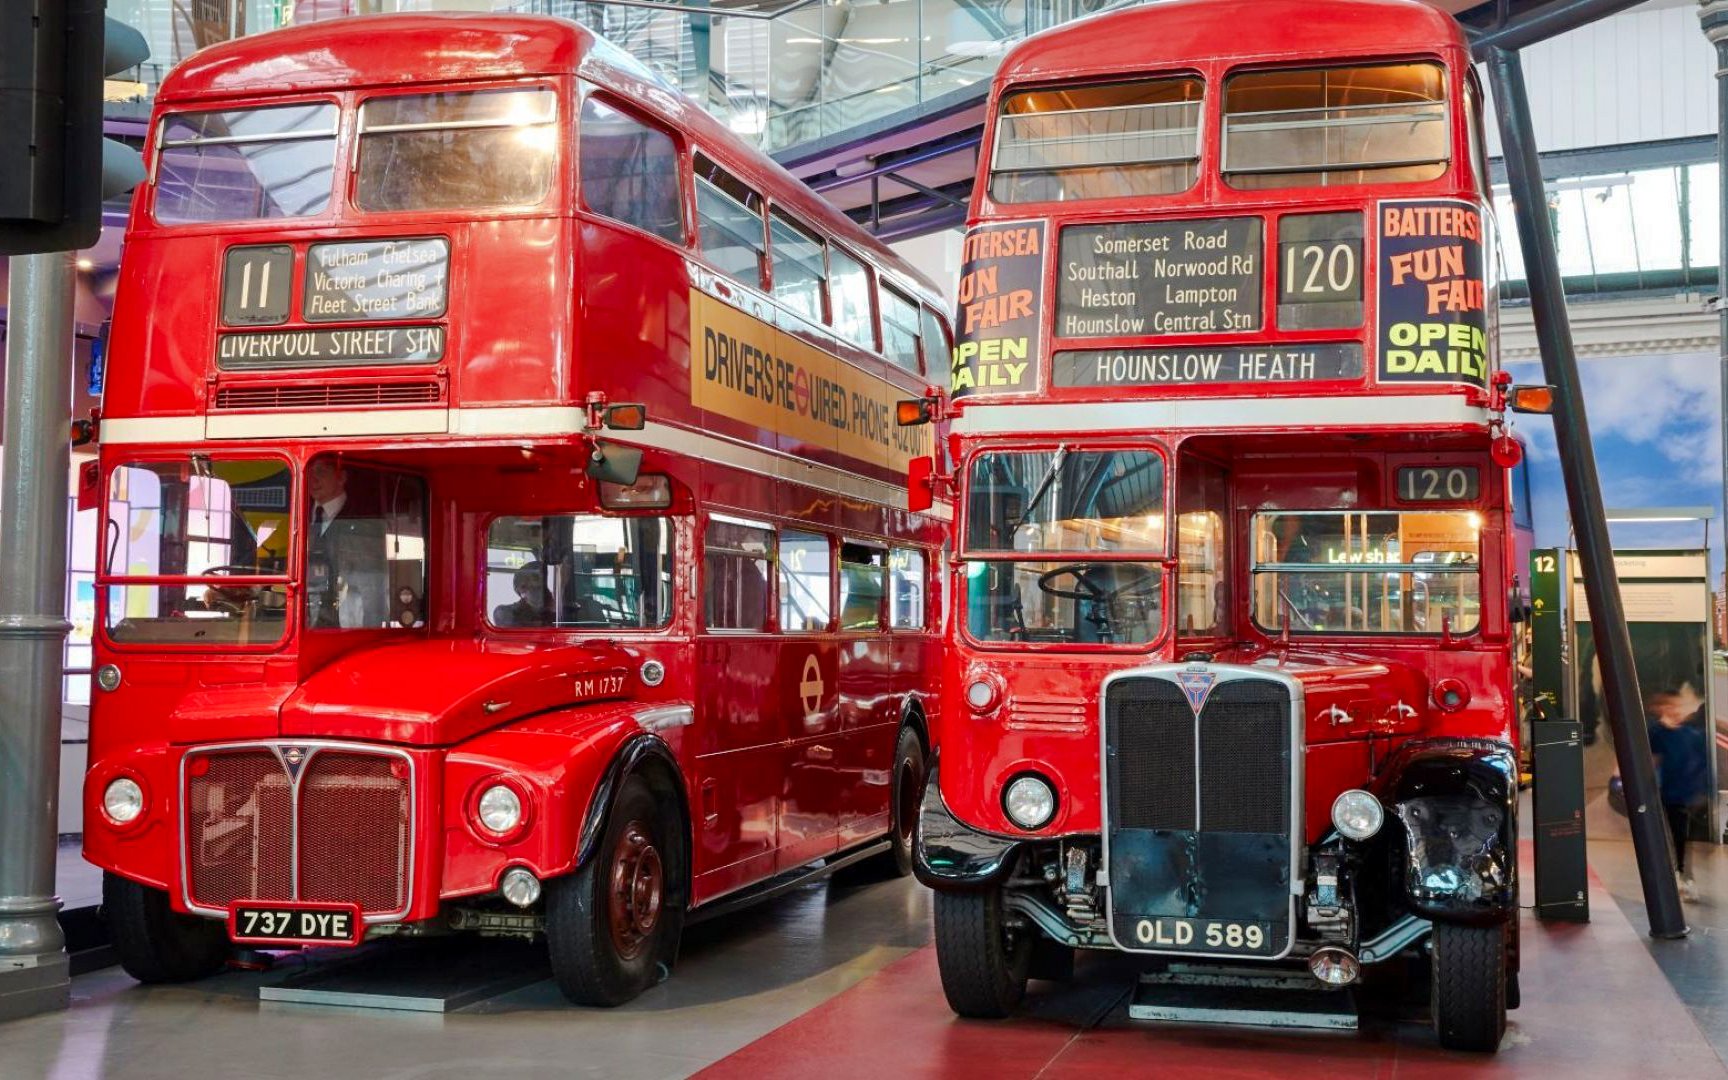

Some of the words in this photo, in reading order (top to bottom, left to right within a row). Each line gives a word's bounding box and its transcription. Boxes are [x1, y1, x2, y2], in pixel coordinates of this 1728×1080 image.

[321, 249, 368, 267] Fulham
[382, 245, 437, 263] Chelsea
[1094, 235, 1170, 254] Somerset
[1184, 230, 1228, 250] Road
[314, 272, 366, 291] Victoria
[377, 268, 426, 291] Charing
[1068, 260, 1139, 281] Southall
[1154, 255, 1227, 278] Norwood
[1231, 255, 1254, 275] Rd
[1286, 244, 1355, 294] 120
[1390, 246, 1465, 286] FUN
[240, 261, 270, 309] 11
[1081, 289, 1136, 308] Heston
[1165, 284, 1237, 307] Lampton
[311, 295, 347, 313] Fleet
[352, 292, 398, 312] Street
[406, 291, 442, 310] Bank
[965, 289, 1034, 335] FAIR
[1066, 313, 1145, 335] Hounslow
[1154, 310, 1216, 331] Central
[1222, 309, 1251, 329] Stn
[221, 331, 320, 358] LIVERPOOL
[329, 329, 394, 355] STREET
[405, 327, 440, 353] STN
[1389, 322, 1486, 357] OPEN
[1096, 353, 1223, 382] HOUNSLOW
[1238, 352, 1316, 380] HEATH
[1386, 350, 1487, 381] DAILY
[705, 325, 774, 404] DRIVERS
[852, 392, 889, 447] PHONE
[1408, 469, 1467, 499] 120
[1534, 556, 1555, 573] 12
[574, 680, 594, 697] RM
[599, 676, 624, 694] 1737
[244, 911, 291, 935] 737
[301, 913, 348, 937] DYE
[1136, 920, 1194, 945] OLD
[1205, 923, 1264, 949] 589
